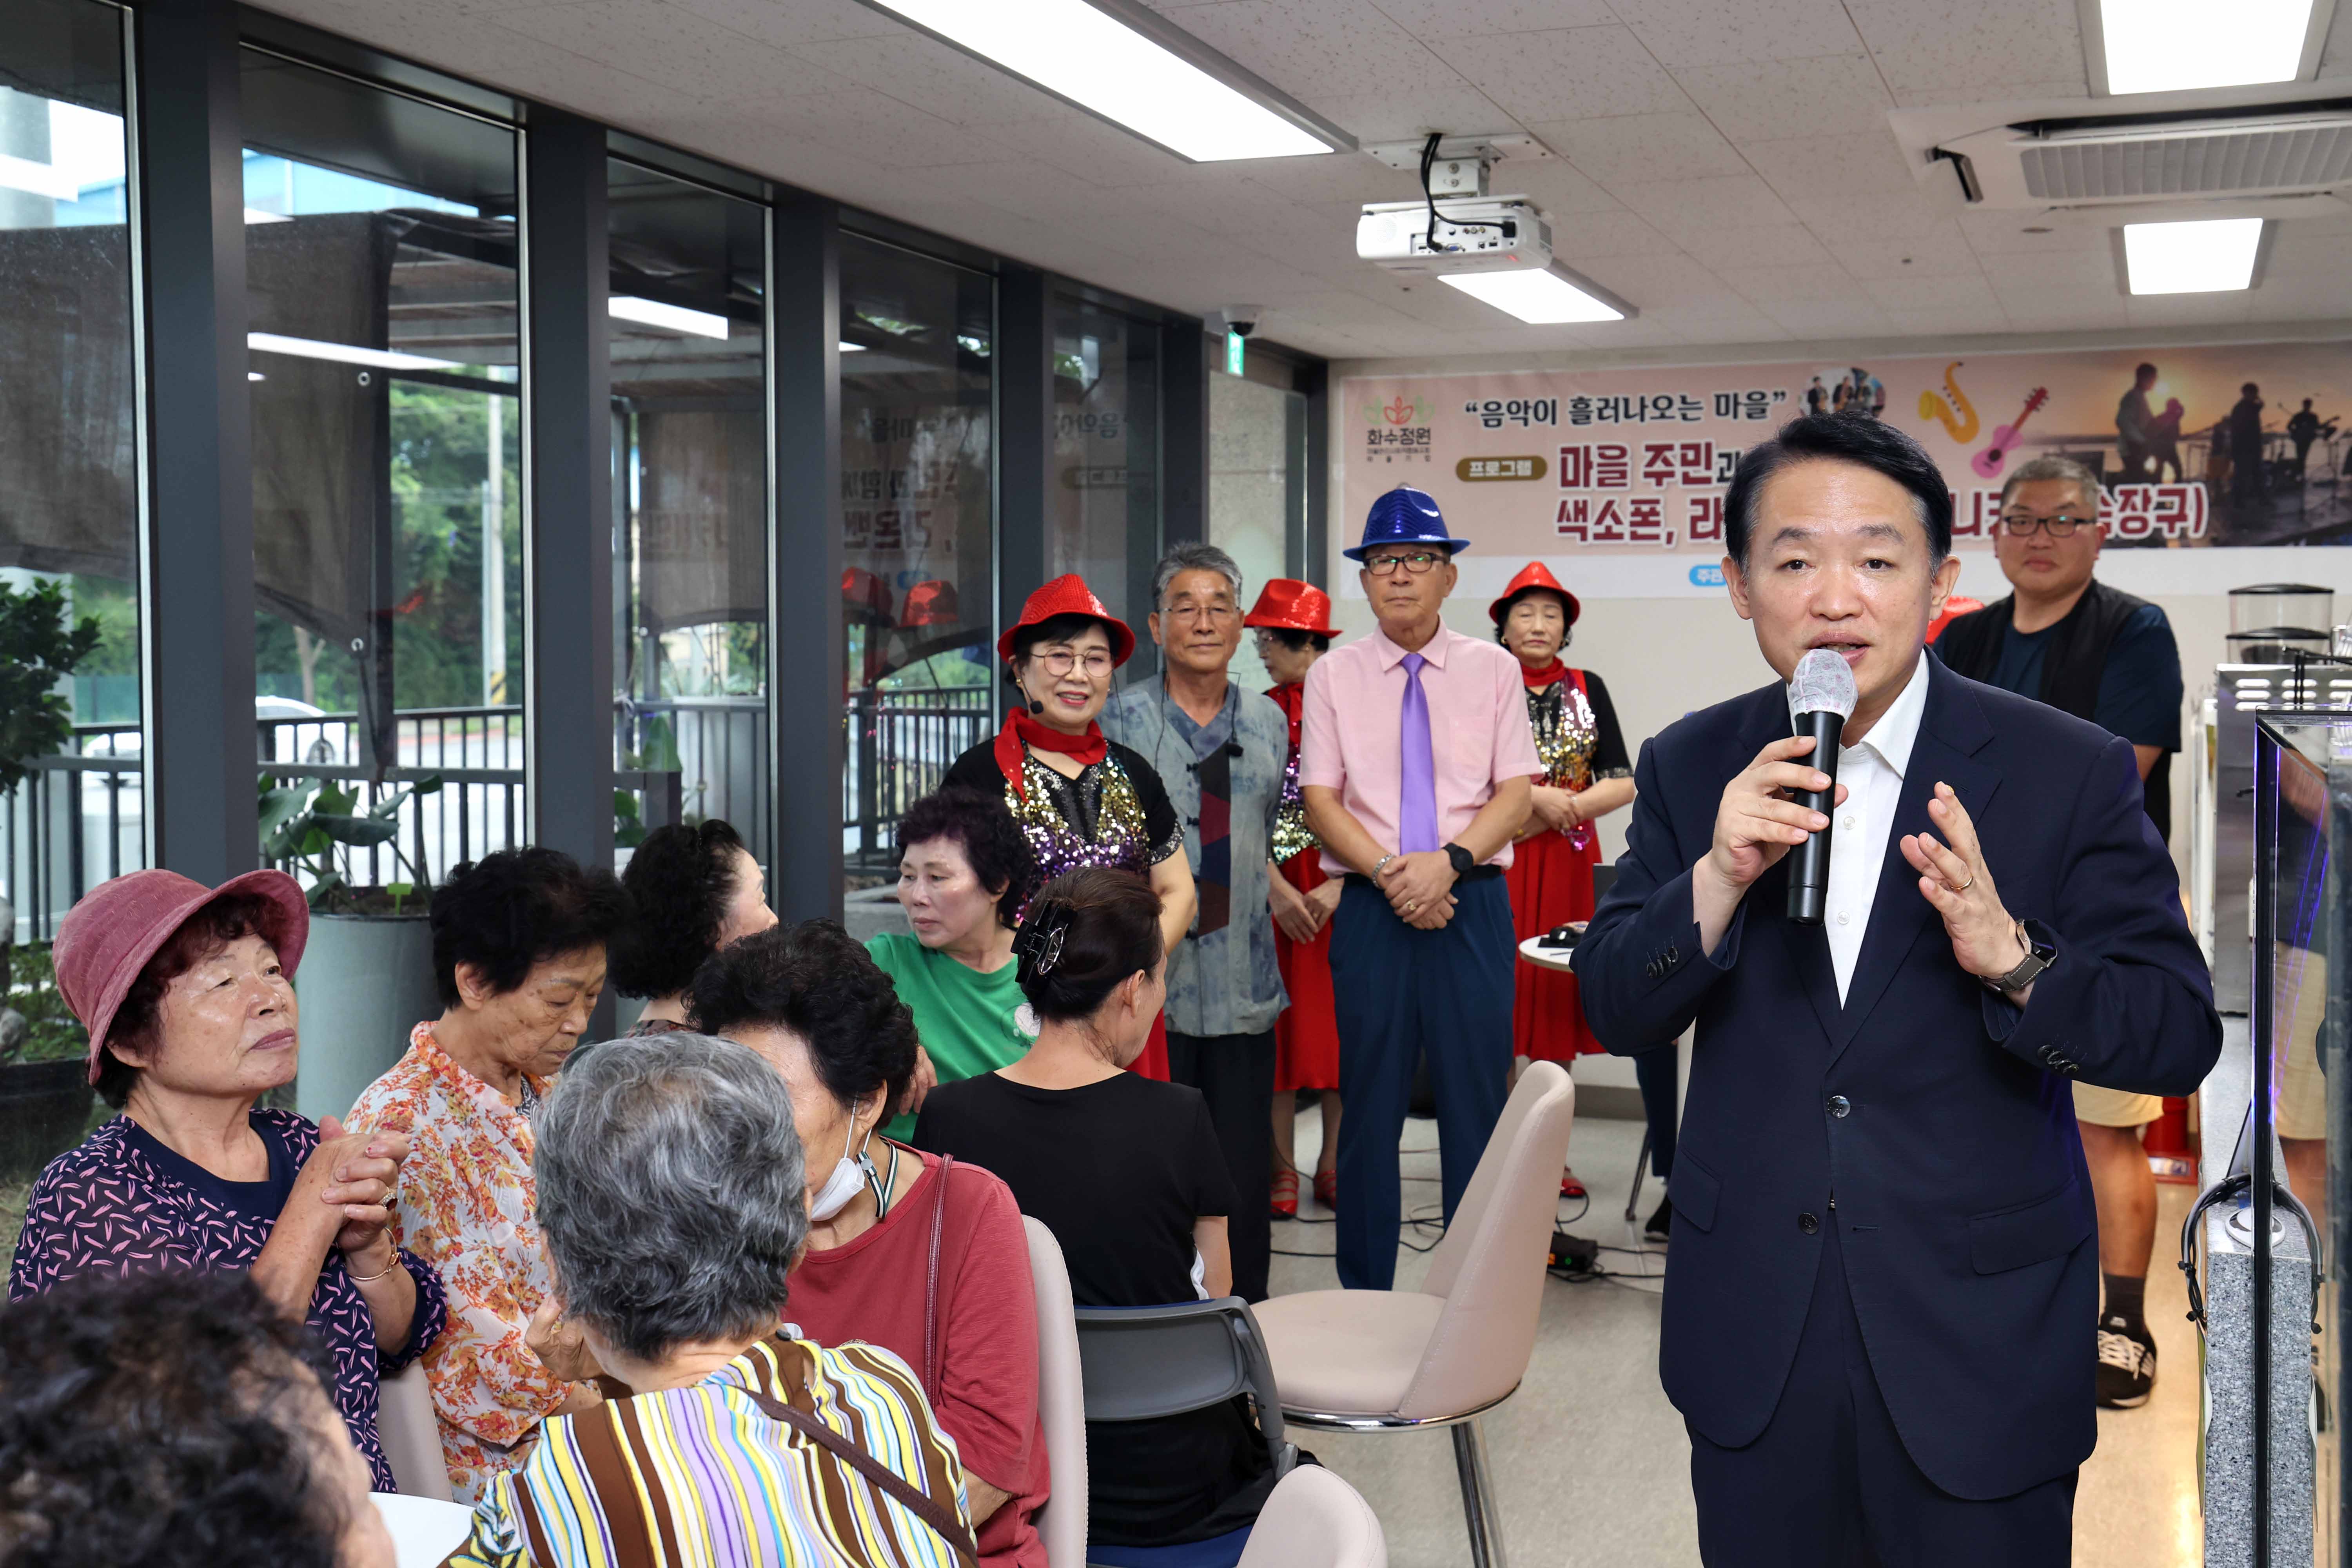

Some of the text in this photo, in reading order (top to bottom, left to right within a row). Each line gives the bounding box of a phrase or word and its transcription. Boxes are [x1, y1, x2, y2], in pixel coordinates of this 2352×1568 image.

[1465, 391, 1786, 428] “음악이 흘러나오는 마을”
[1367, 428, 1430, 445] 화수정원
[1469, 460, 1532, 477] 프로그램
[1561, 445, 1628, 487] 마을
[1557, 499, 1674, 544] 색소폰,
